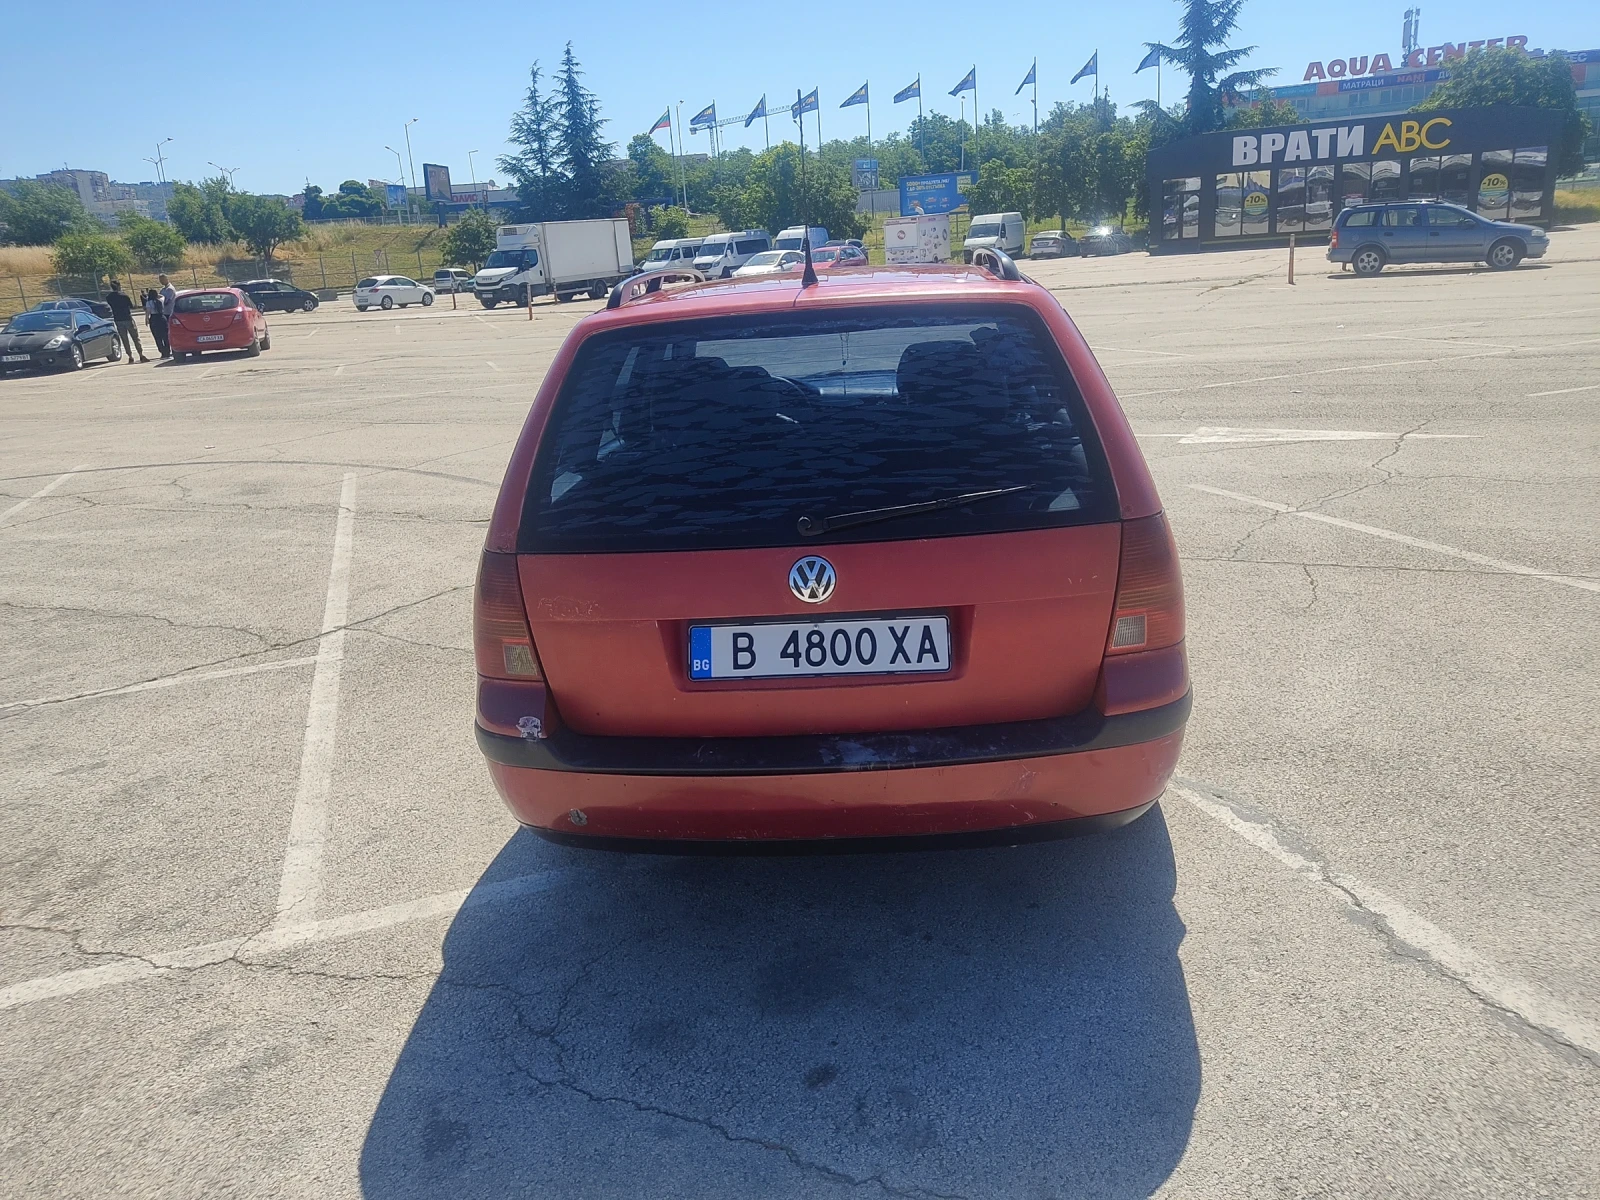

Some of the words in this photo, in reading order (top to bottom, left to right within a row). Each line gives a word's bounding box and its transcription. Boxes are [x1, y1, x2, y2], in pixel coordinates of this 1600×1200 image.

[1303, 53, 1392, 81] AQUA
[1342, 79, 1384, 90] МАТРАЦИ
[1232, 125, 1365, 166] ВРАТИ
[1483, 177, 1506, 186] -10%
[1246, 195, 1266, 203] -10%
[732, 632, 756, 670] B
[780, 628, 877, 667] 4800
[888, 625, 940, 664] XA
[693, 659, 710, 671] BG
